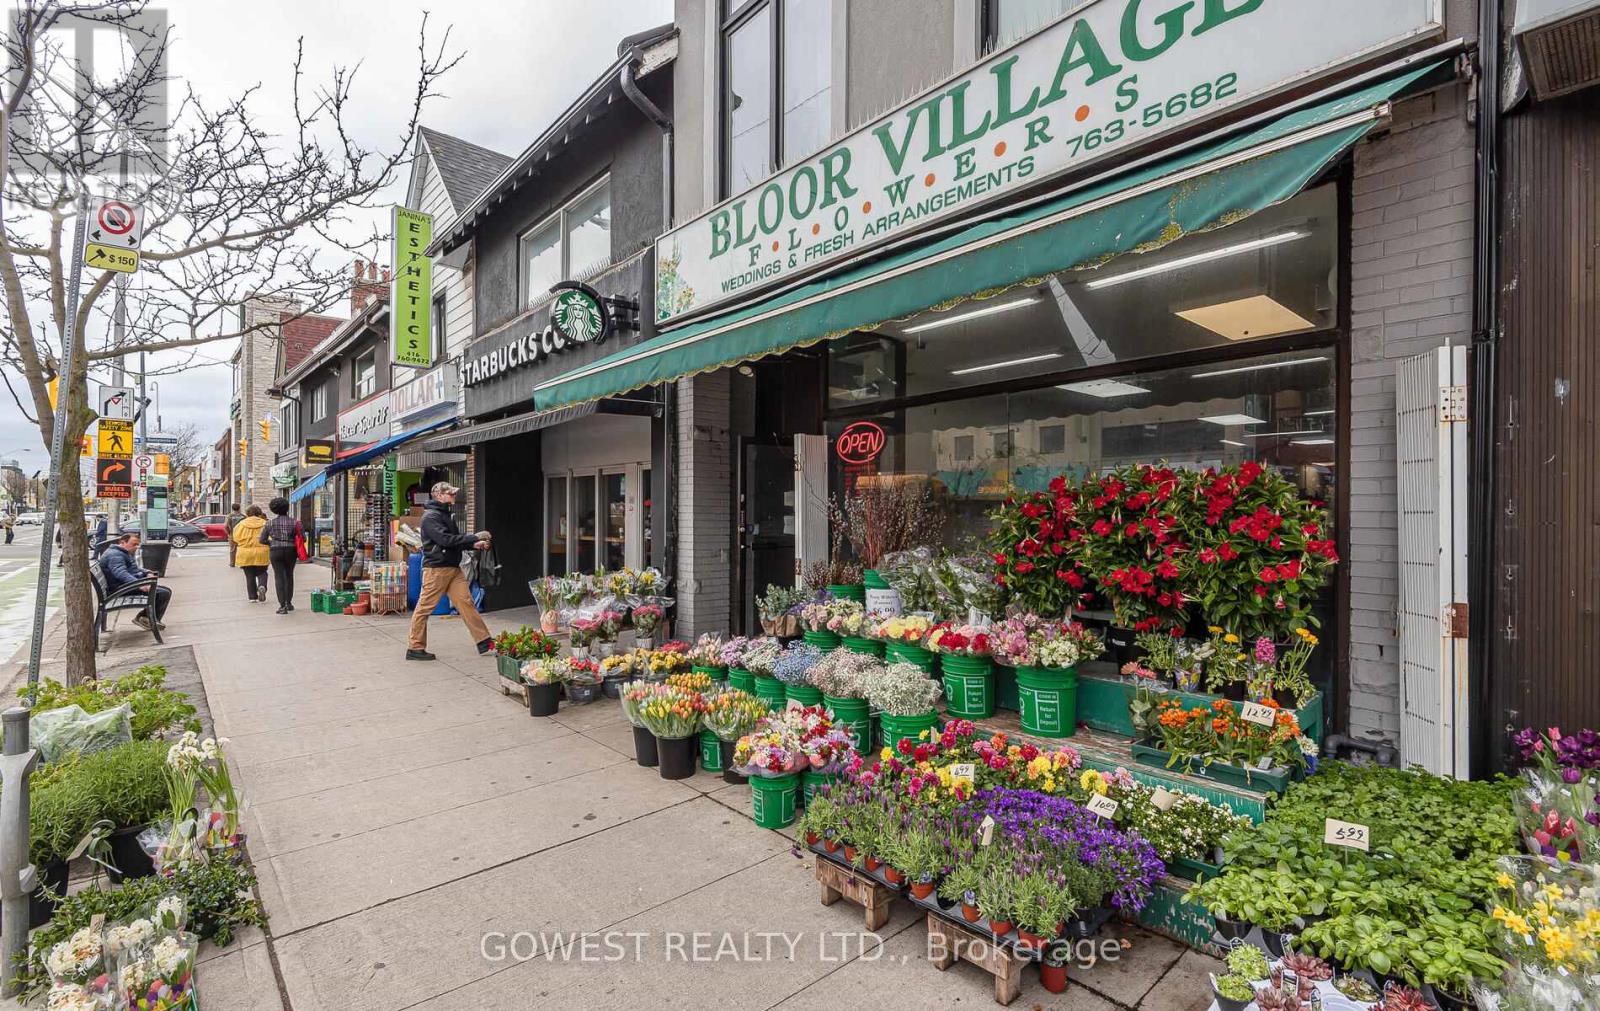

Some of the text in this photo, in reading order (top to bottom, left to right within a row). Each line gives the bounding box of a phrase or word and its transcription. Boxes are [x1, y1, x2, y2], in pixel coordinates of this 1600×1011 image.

[708, 146, 859, 260] BLOOR
[721, 72, 1239, 293] WEDDINGS & FRESH ARRANGEMENTS 763-5682
[407, 222, 421, 350] ESTHETICS
[459, 331, 539, 388] STARBUCKS
[840, 432, 880, 454] OPEN
